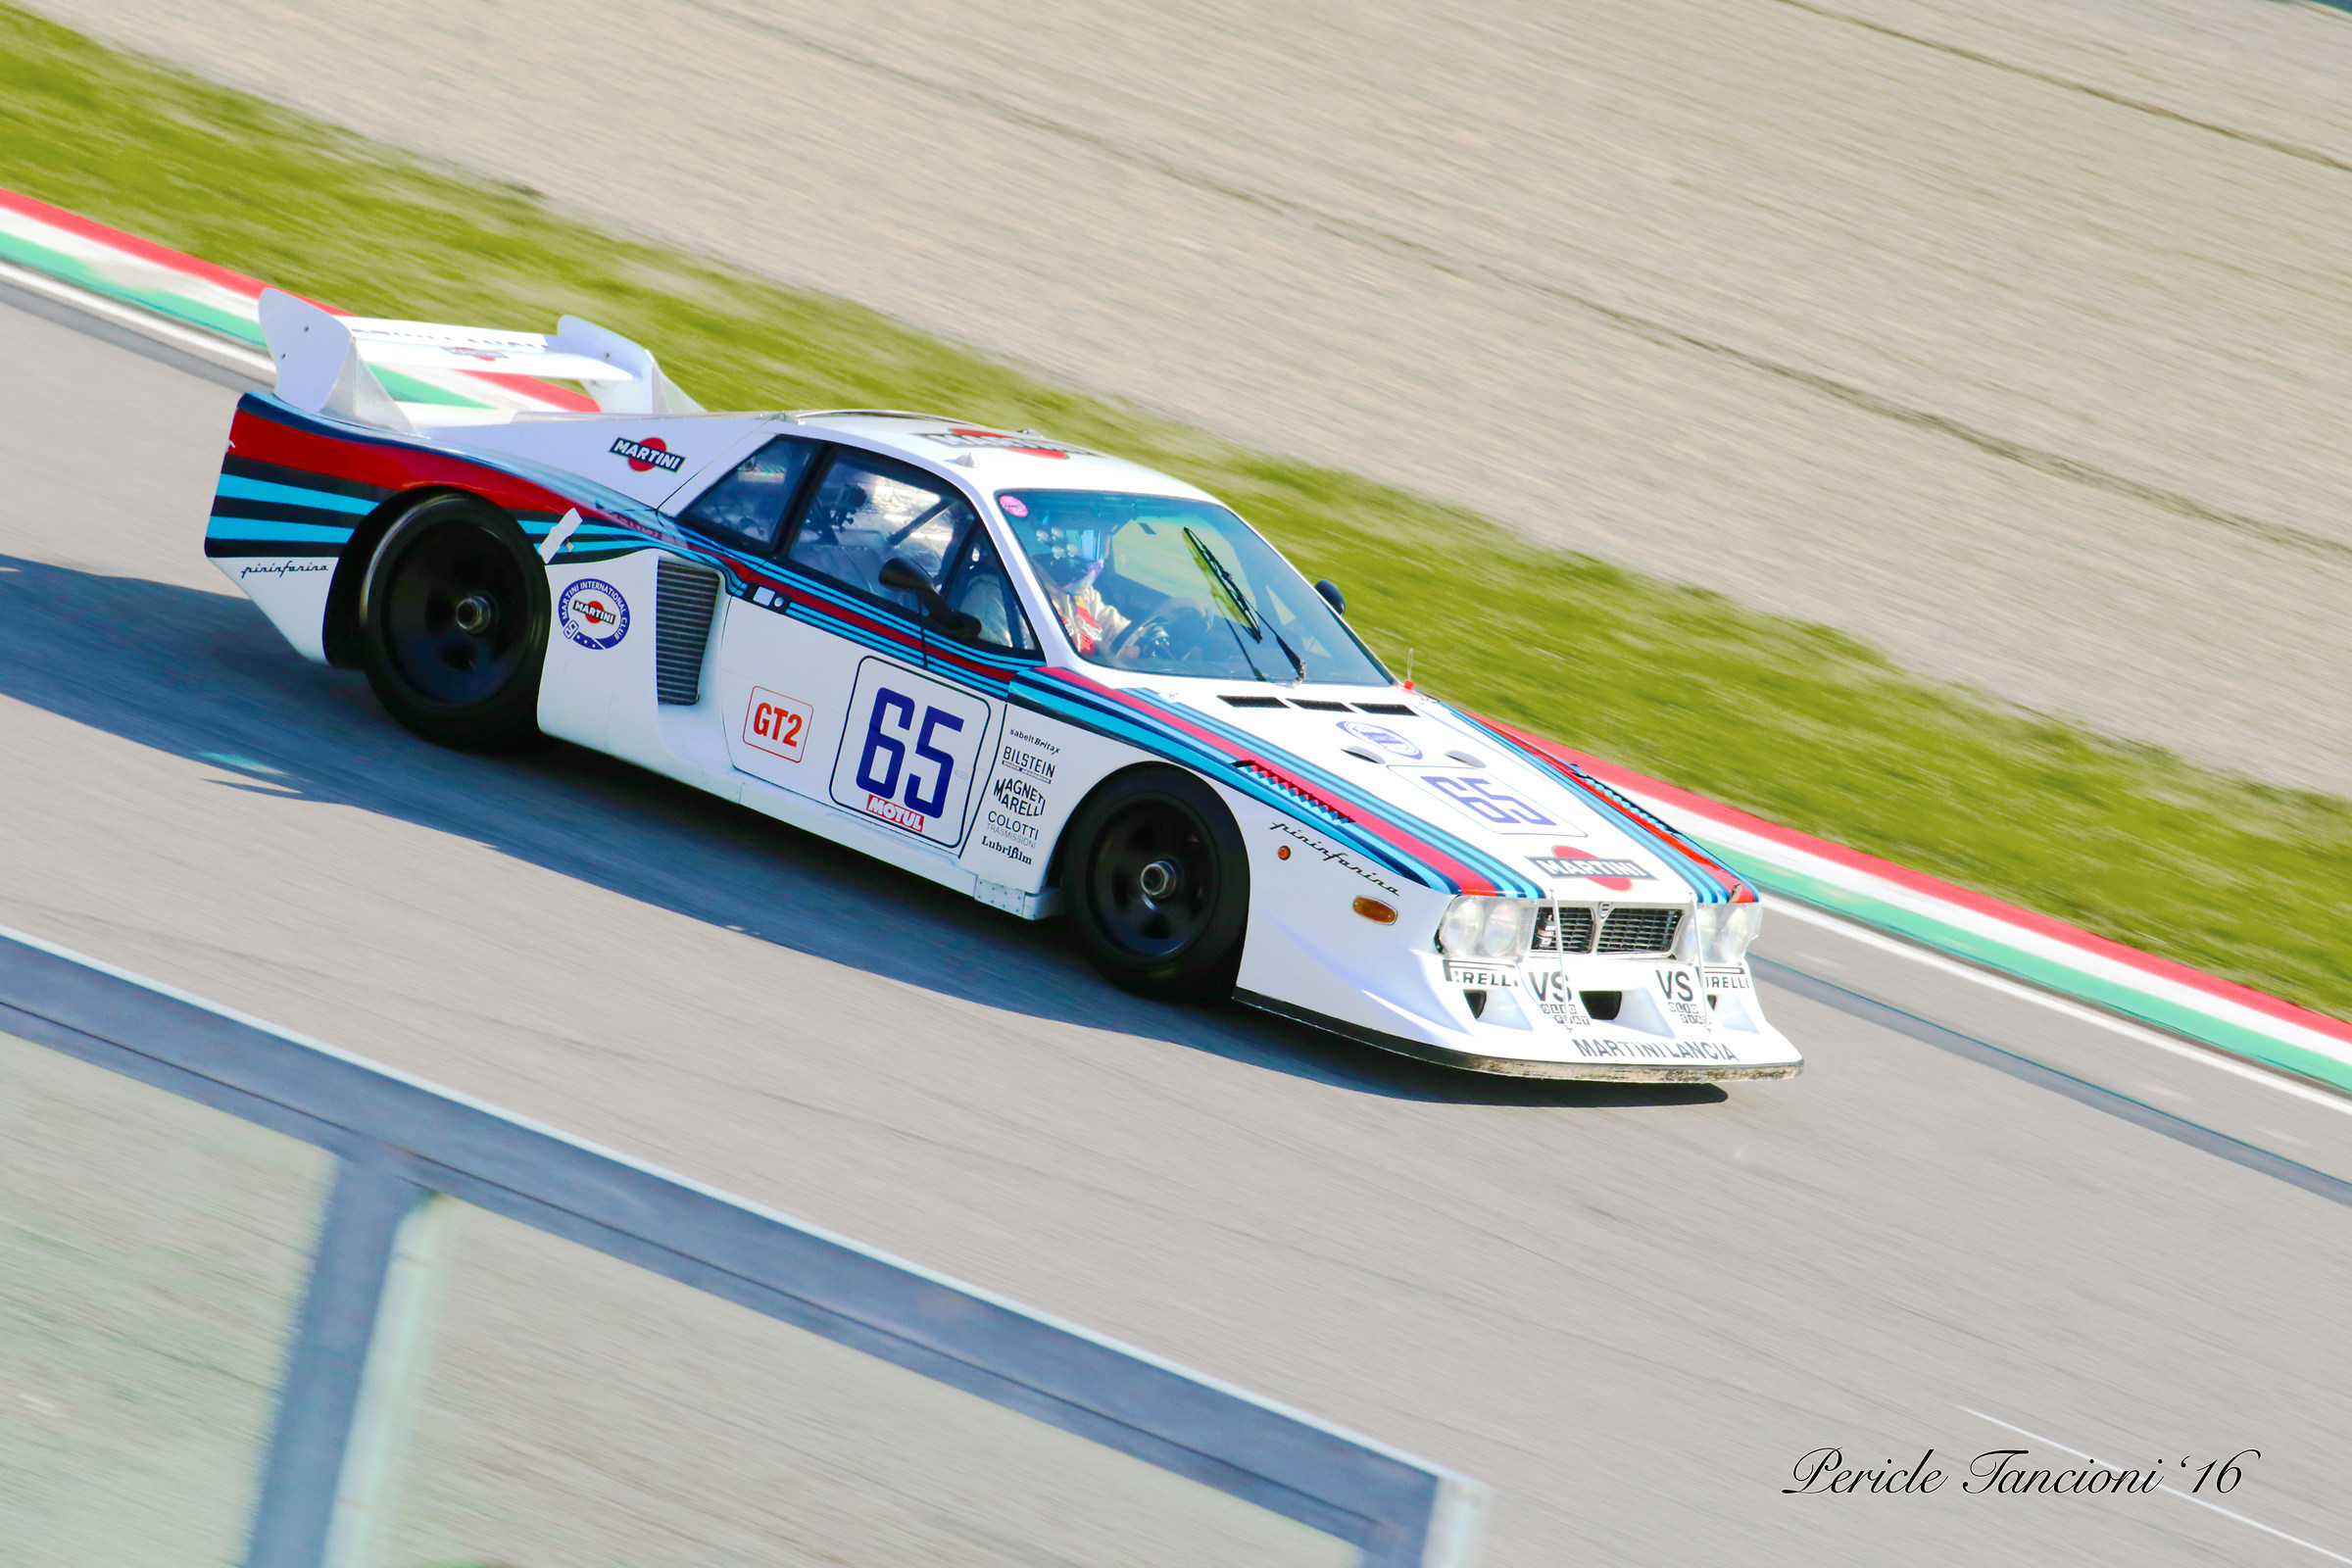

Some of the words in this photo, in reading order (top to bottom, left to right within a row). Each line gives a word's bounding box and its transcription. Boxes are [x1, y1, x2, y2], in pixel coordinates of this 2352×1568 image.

[613, 440, 681, 469] MARTINI
[240, 560, 328, 578] pininfarina
[562, 583, 579, 619] MARTINI
[580, 580, 626, 614] INTERNATIONAL
[613, 616, 627, 640] CLUB
[574, 602, 614, 623] MARTINI
[753, 702, 803, 748] GT2
[856, 687, 964, 819] 65
[1003, 745, 1055, 778] BILSTEIN
[993, 777, 1046, 807] MAGNETI
[993, 781, 1046, 817] MARELLI
[1420, 775, 1557, 826] 65
[867, 796, 924, 831] MOTUL
[988, 810, 1039, 841] COLOTTI
[981, 835, 1032, 865] Lubrifilm
[986, 823, 1036, 849] TRASMISSIONI
[1269, 822, 1399, 897] pininfarina
[1535, 859, 1648, 877] MARTINI
[1528, 970, 1572, 1003] VS
[1655, 969, 1693, 1002] VS
[1572, 1039, 1667, 1058] MARTINI
[1661, 1041, 1740, 1062] LANCIA
